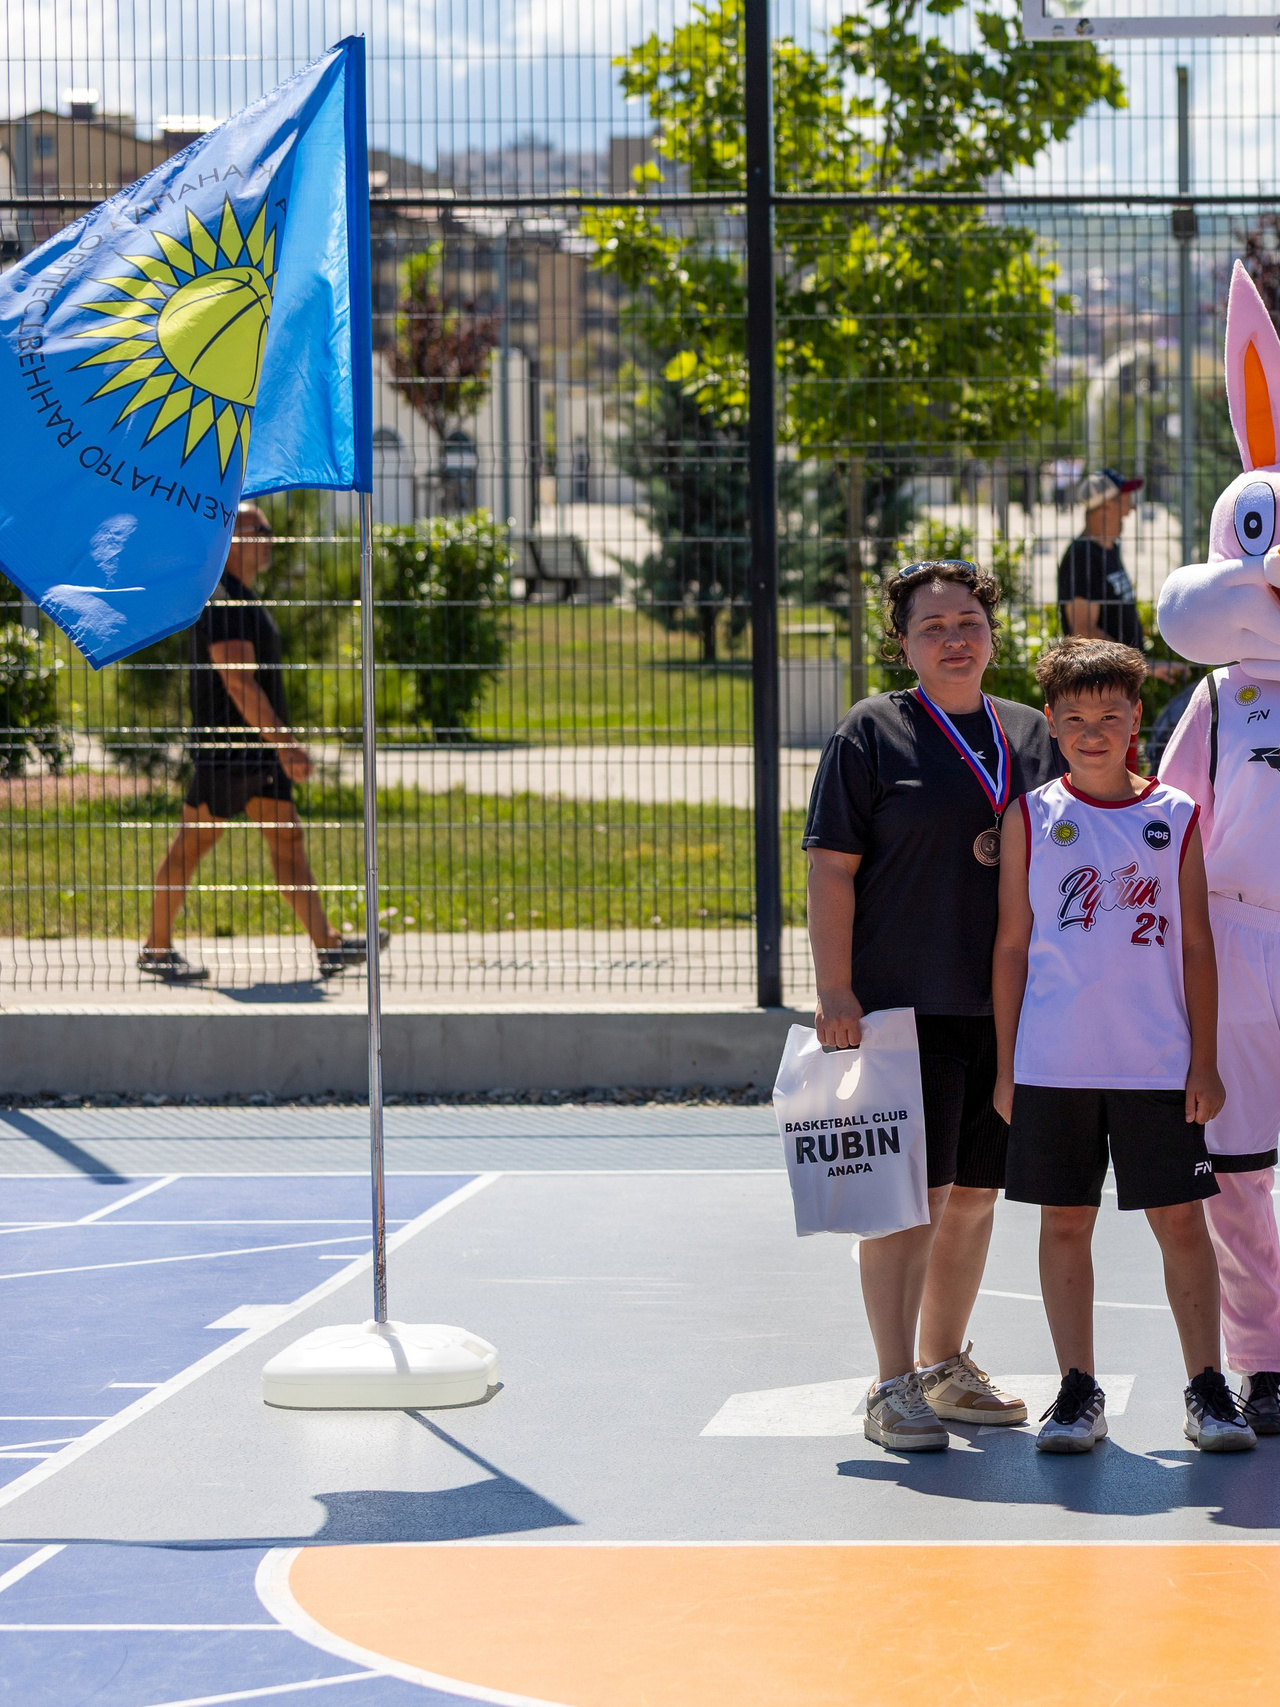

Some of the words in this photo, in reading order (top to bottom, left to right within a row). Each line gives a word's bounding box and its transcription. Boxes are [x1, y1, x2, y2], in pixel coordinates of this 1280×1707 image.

[1247, 709, 1270, 724] FN
[1147, 830, 1169, 840] РФБ
[1057, 861, 1161, 932] Рубин
[785, 1115, 868, 1132] BASKETBALL
[872, 1110, 908, 1123] CLUB
[795, 1126, 900, 1164] RUBIN
[827, 1163, 873, 1177] ANAPA
[1194, 1160, 1212, 1176] FN
